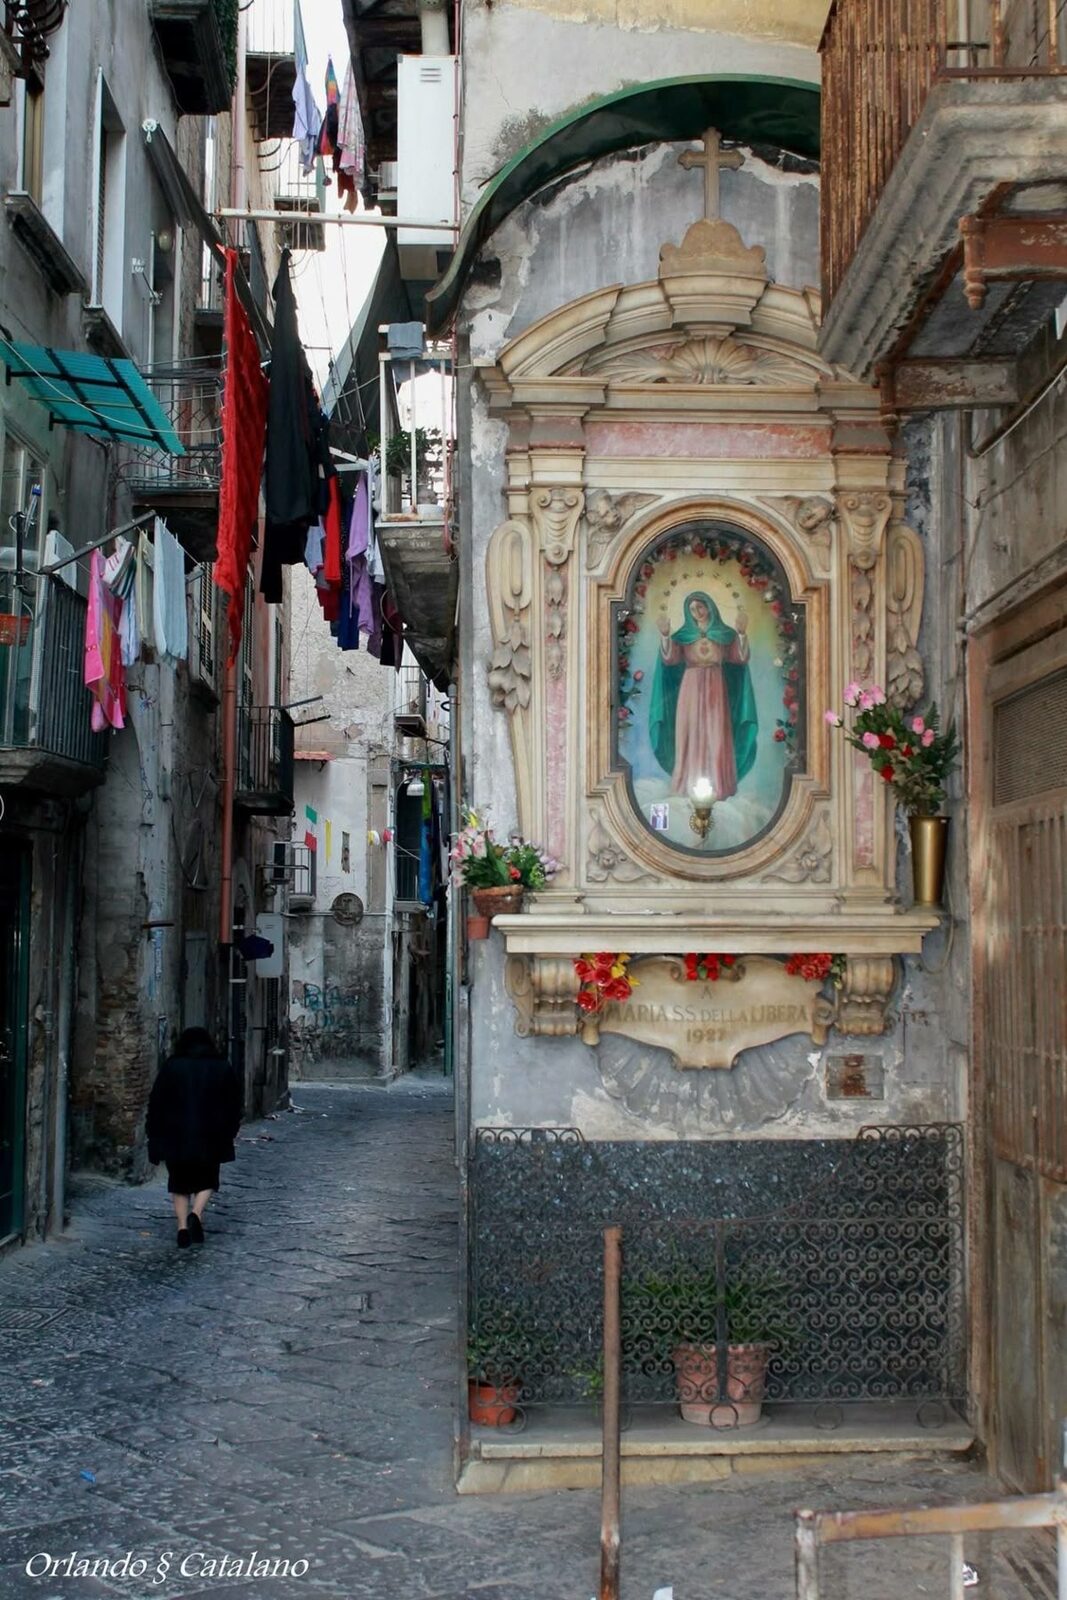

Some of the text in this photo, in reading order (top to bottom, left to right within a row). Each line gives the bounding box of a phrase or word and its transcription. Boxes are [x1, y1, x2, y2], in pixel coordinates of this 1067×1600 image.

[605, 1004, 668, 1022] MARIA
[700, 1008, 748, 1023] DELLA
[750, 1004, 808, 1022] LIBERA
